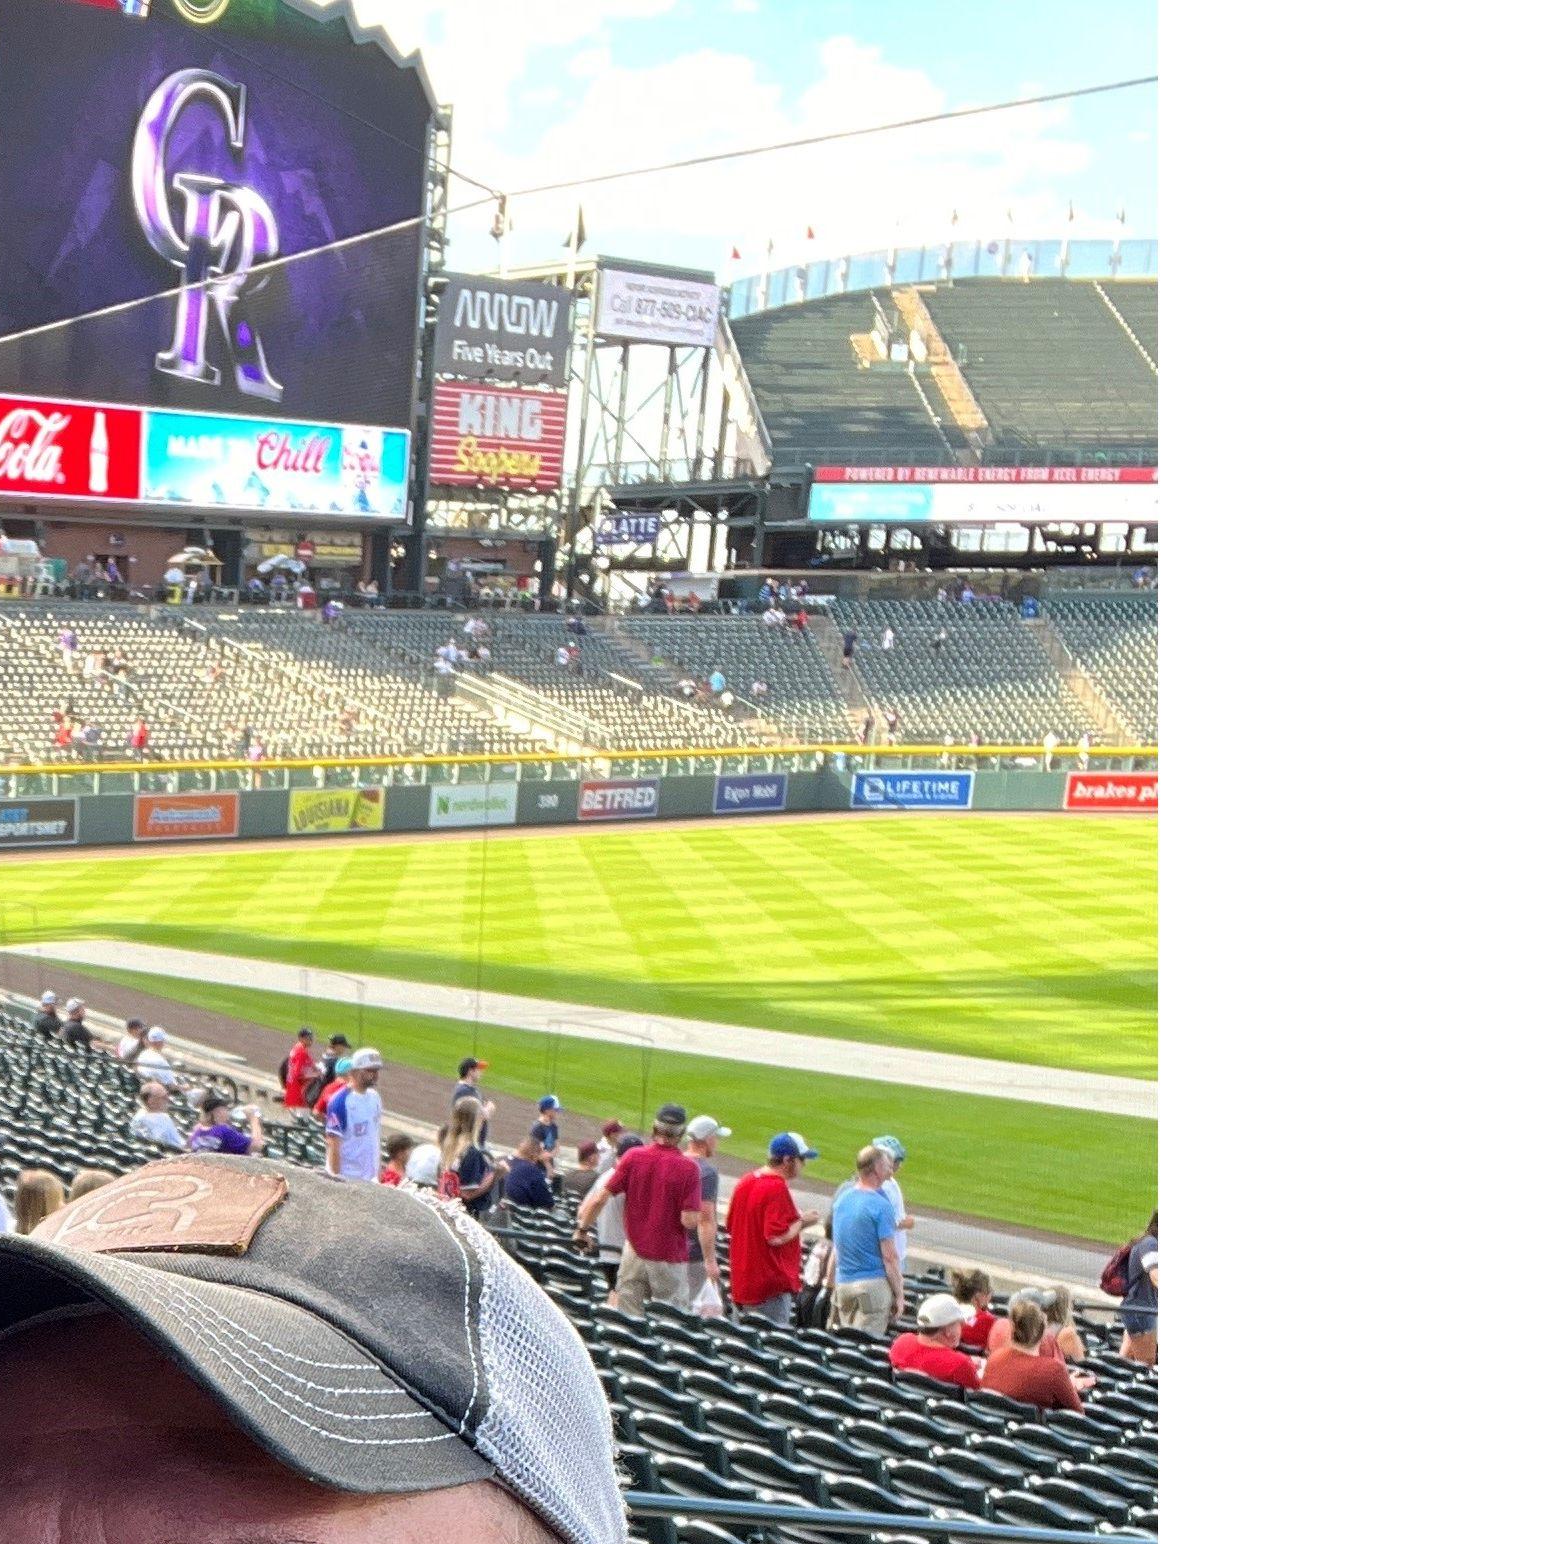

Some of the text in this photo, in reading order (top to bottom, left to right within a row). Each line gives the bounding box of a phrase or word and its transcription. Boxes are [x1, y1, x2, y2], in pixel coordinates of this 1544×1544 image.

[454, 289, 558, 337] ARROW
[453, 339, 554, 371] Five Years Out
[458, 392, 543, 441] KING
[257, 431, 332, 474] Chill
[598, 517, 658, 534] LATTE
[581, 787, 656, 810] BETFRED
[885, 780, 960, 795] LIFETIME
[1074, 781, 1136, 799] brakes
